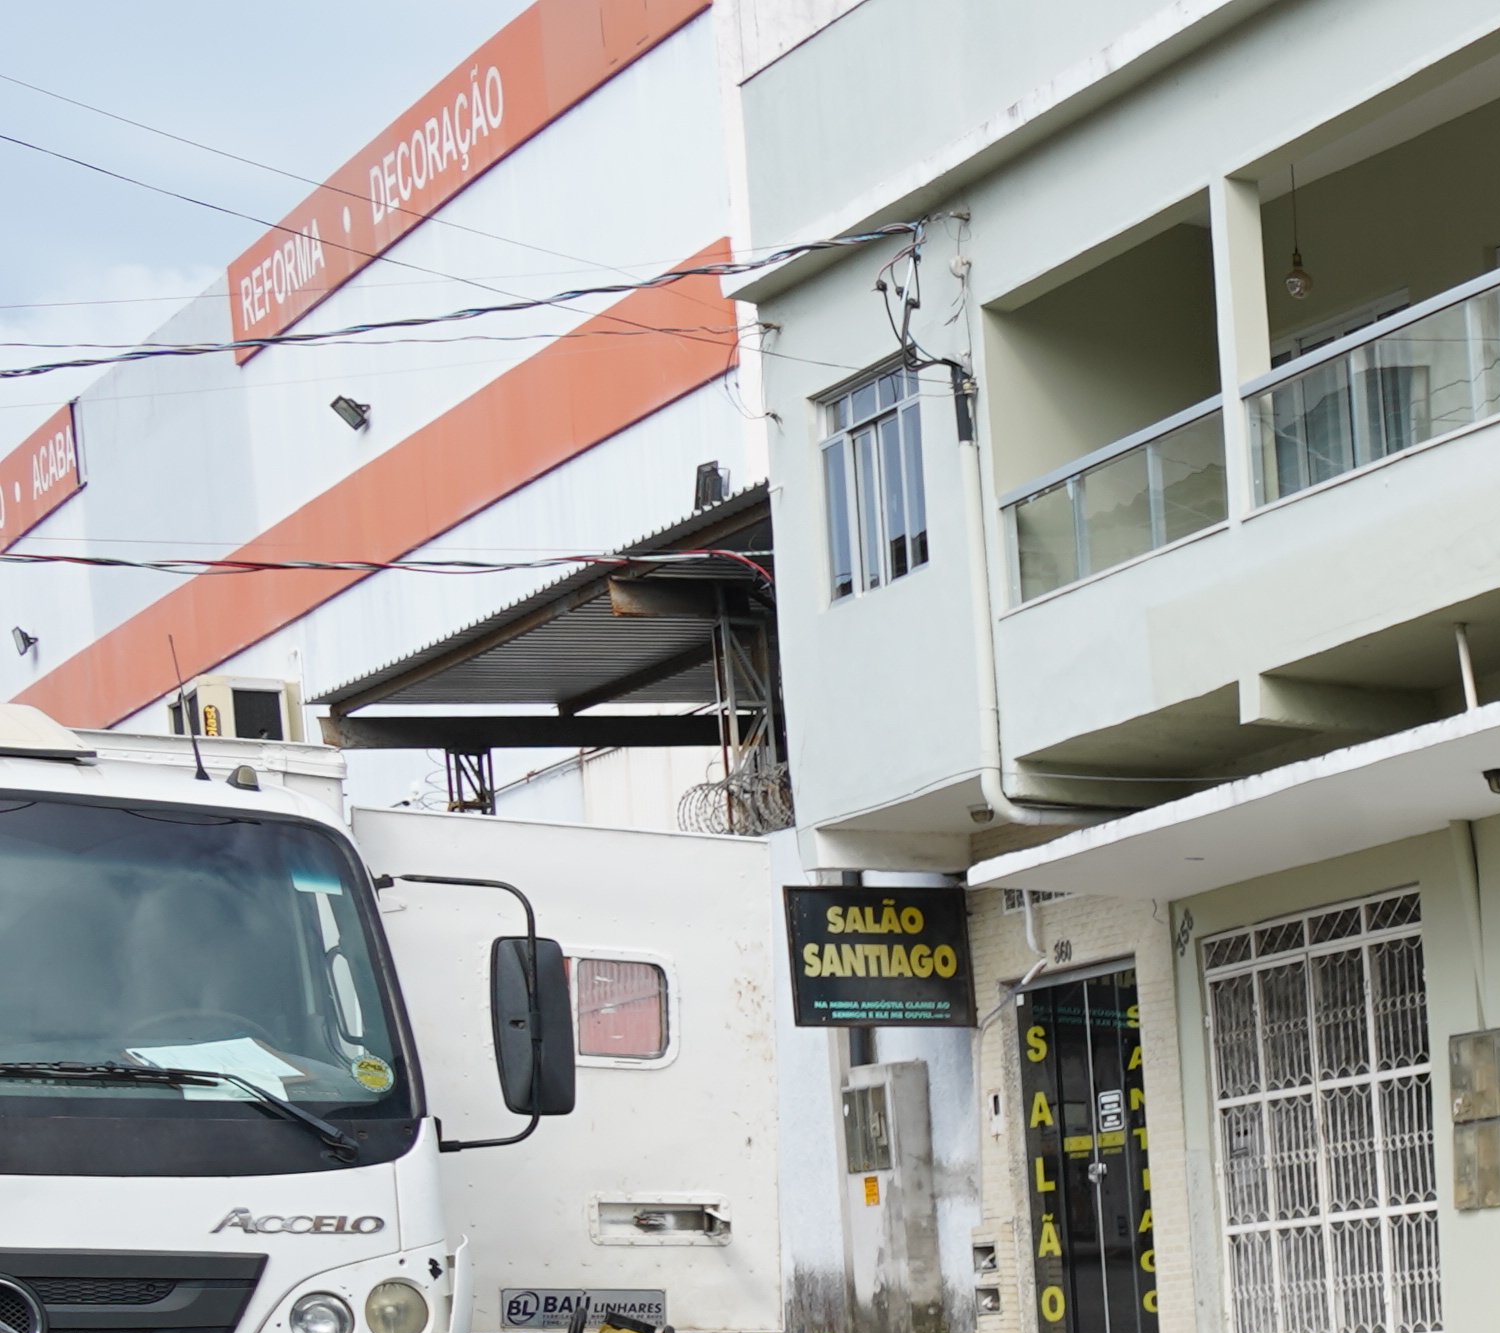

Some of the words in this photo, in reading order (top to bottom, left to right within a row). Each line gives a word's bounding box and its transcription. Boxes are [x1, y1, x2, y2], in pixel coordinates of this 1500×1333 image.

[240, 218, 325, 331] REFORMA
[369, 63, 504, 225] DECORAÇÃO
[826, 898, 925, 934] SALÃO
[803, 942, 957, 978] SANTIAGO
[1026, 1025, 1066, 1322] SALÃO
[209, 1206, 386, 1235] ACCELO
[507, 1299, 537, 1316] BL
[593, 1302, 663, 1314] LINHARES
